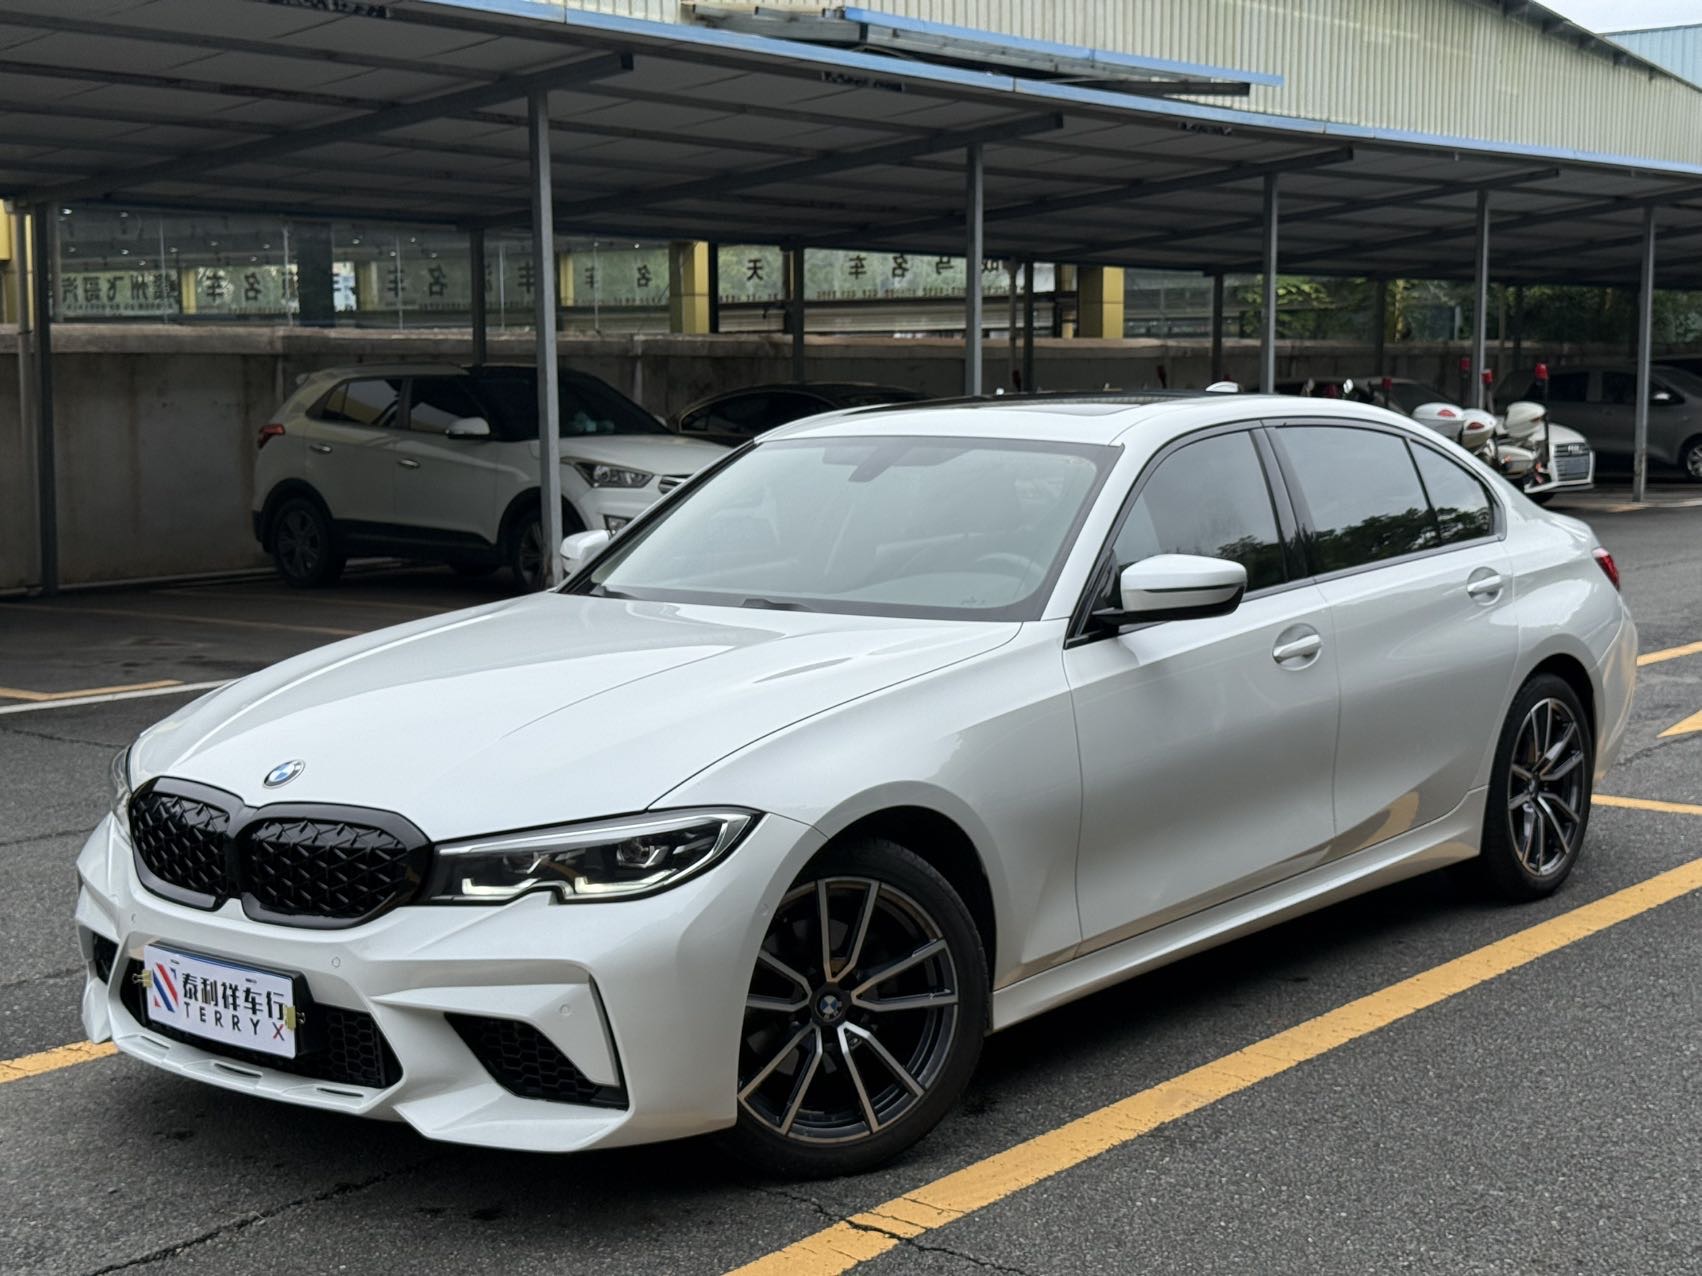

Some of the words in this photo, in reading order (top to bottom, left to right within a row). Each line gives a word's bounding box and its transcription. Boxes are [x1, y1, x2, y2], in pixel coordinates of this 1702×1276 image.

[181, 972, 286, 1021] 泰利祥车行
